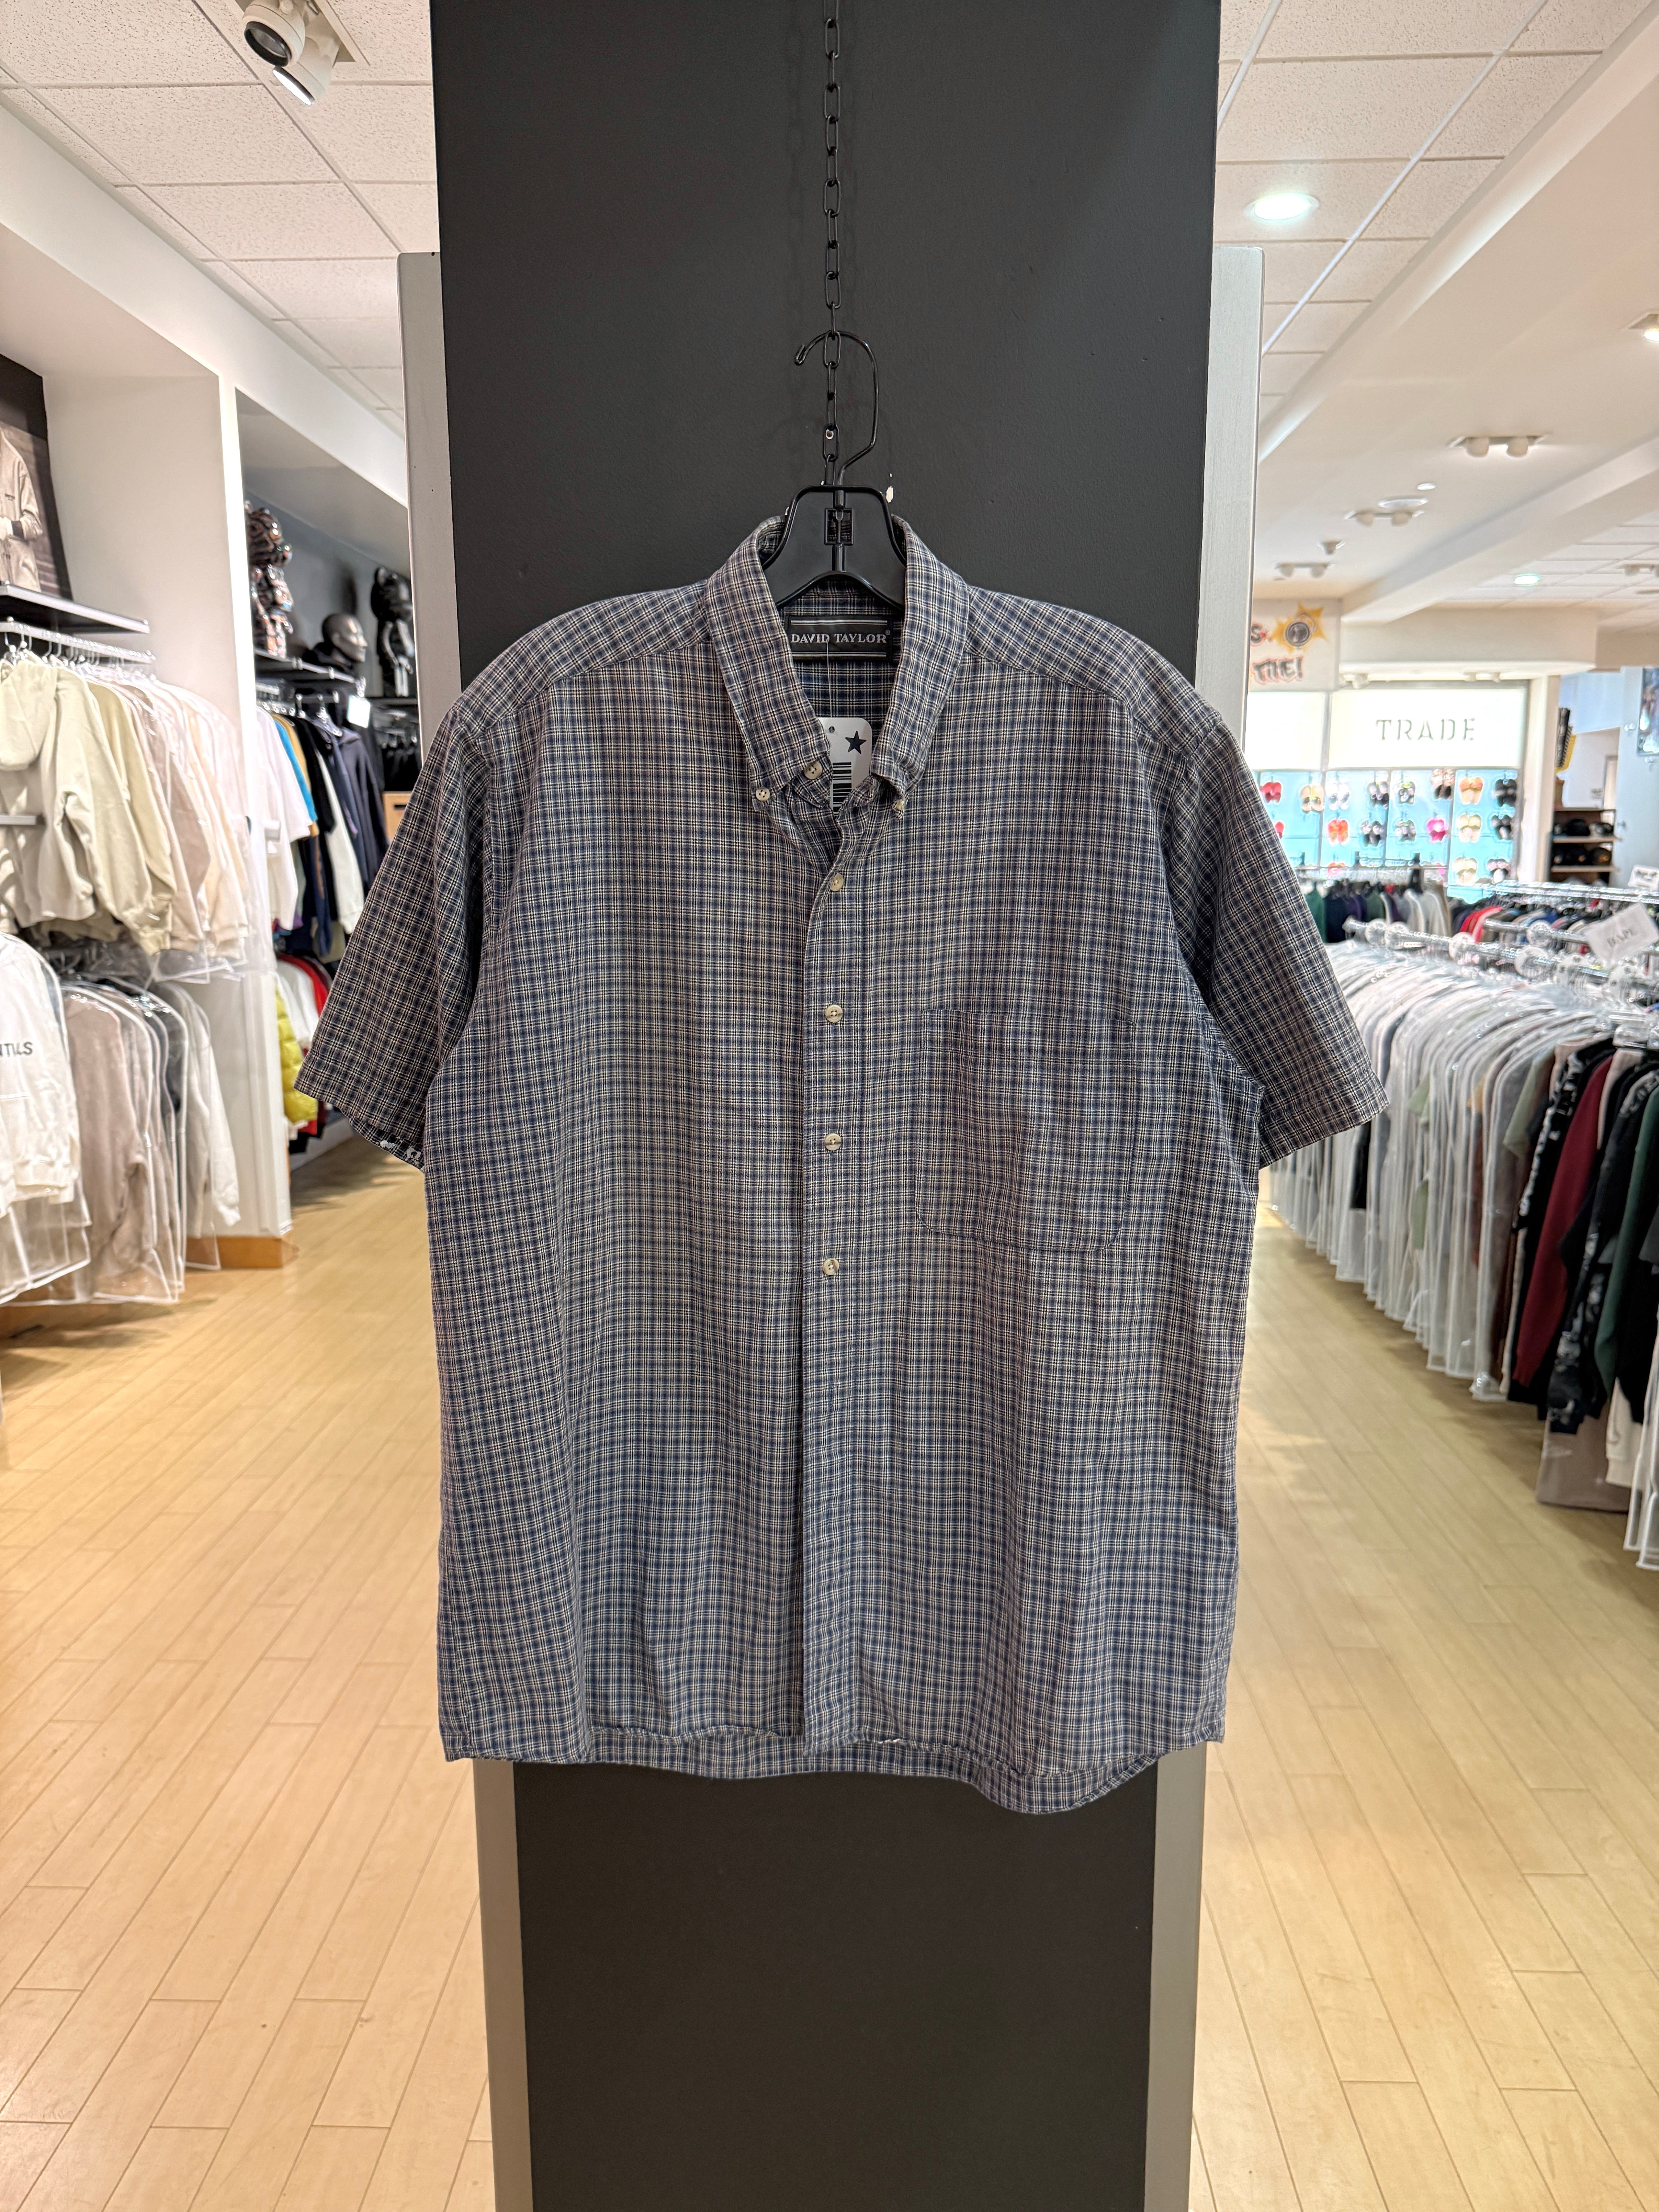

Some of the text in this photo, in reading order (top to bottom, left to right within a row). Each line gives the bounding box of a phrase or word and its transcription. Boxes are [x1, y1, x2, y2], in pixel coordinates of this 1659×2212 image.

[791, 633, 886, 643] DAVID TAYLOR
[1376, 718, 1475, 741] TRADE
